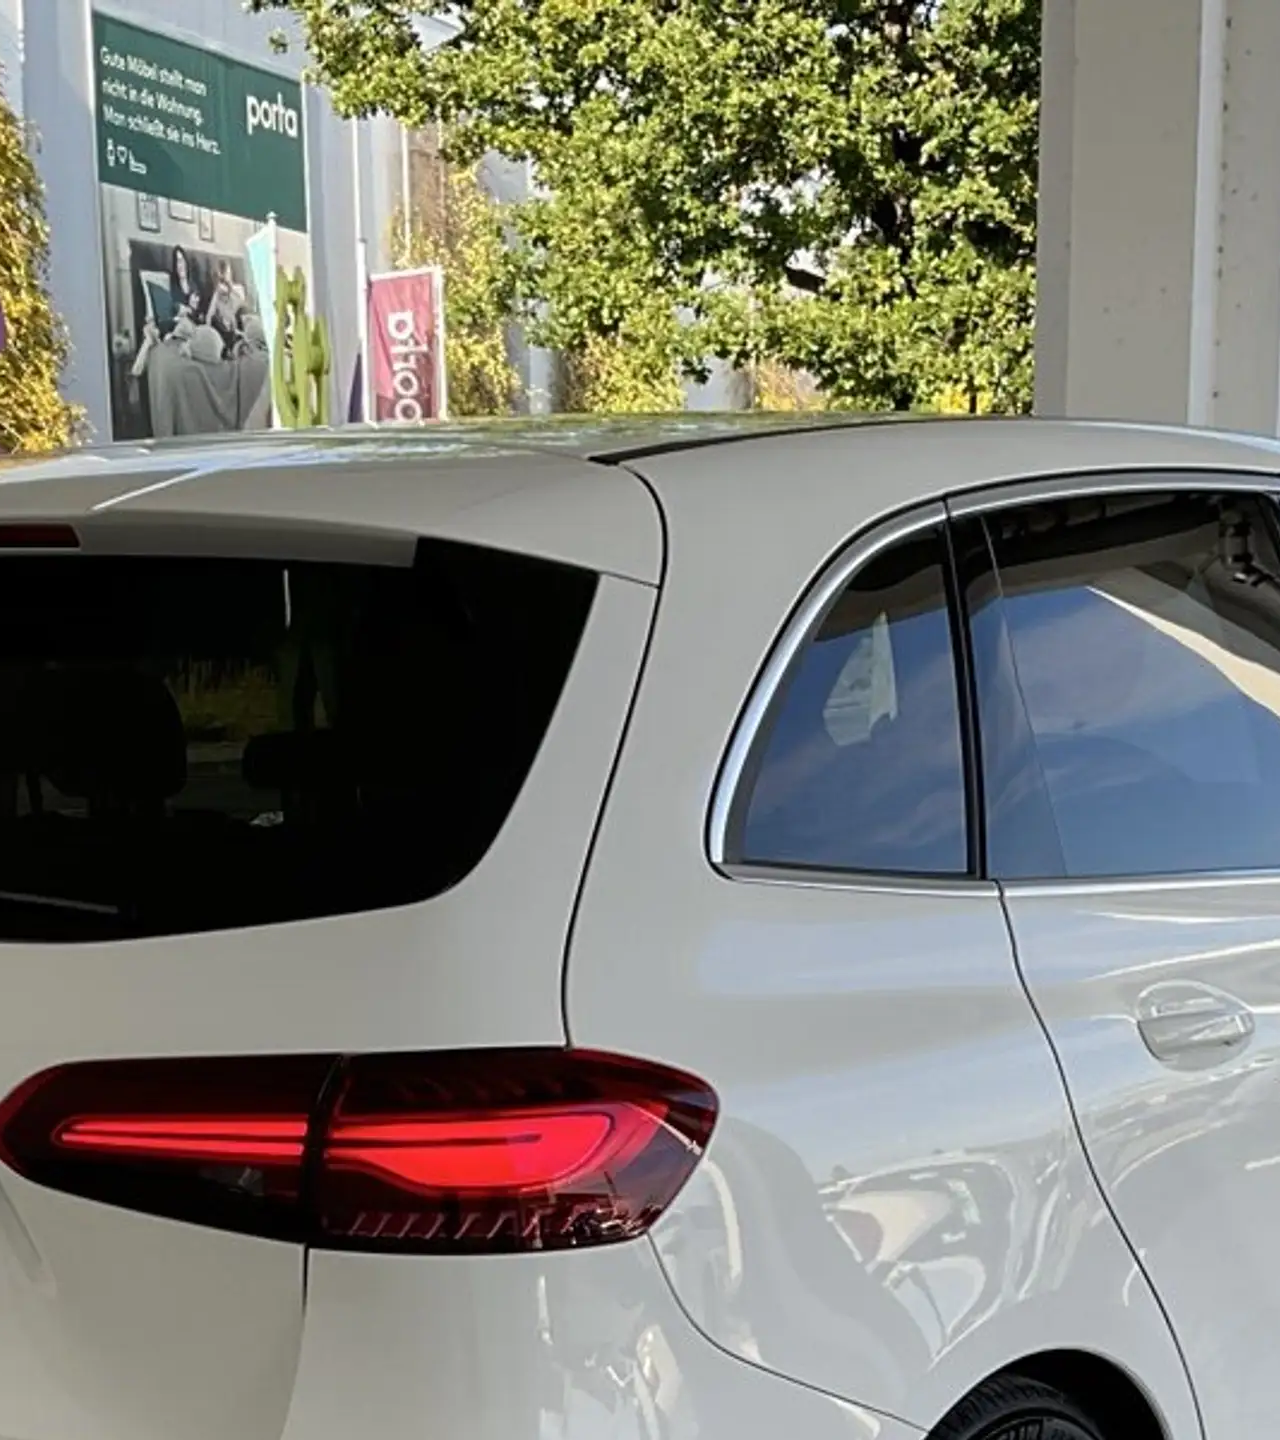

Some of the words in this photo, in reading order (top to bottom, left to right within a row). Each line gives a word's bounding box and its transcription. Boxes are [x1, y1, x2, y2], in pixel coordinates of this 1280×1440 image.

[100, 45, 125, 71] Gute
[102, 103, 127, 127] Man
[246, 91, 299, 138] porta
[387, 310, 429, 426] porta
